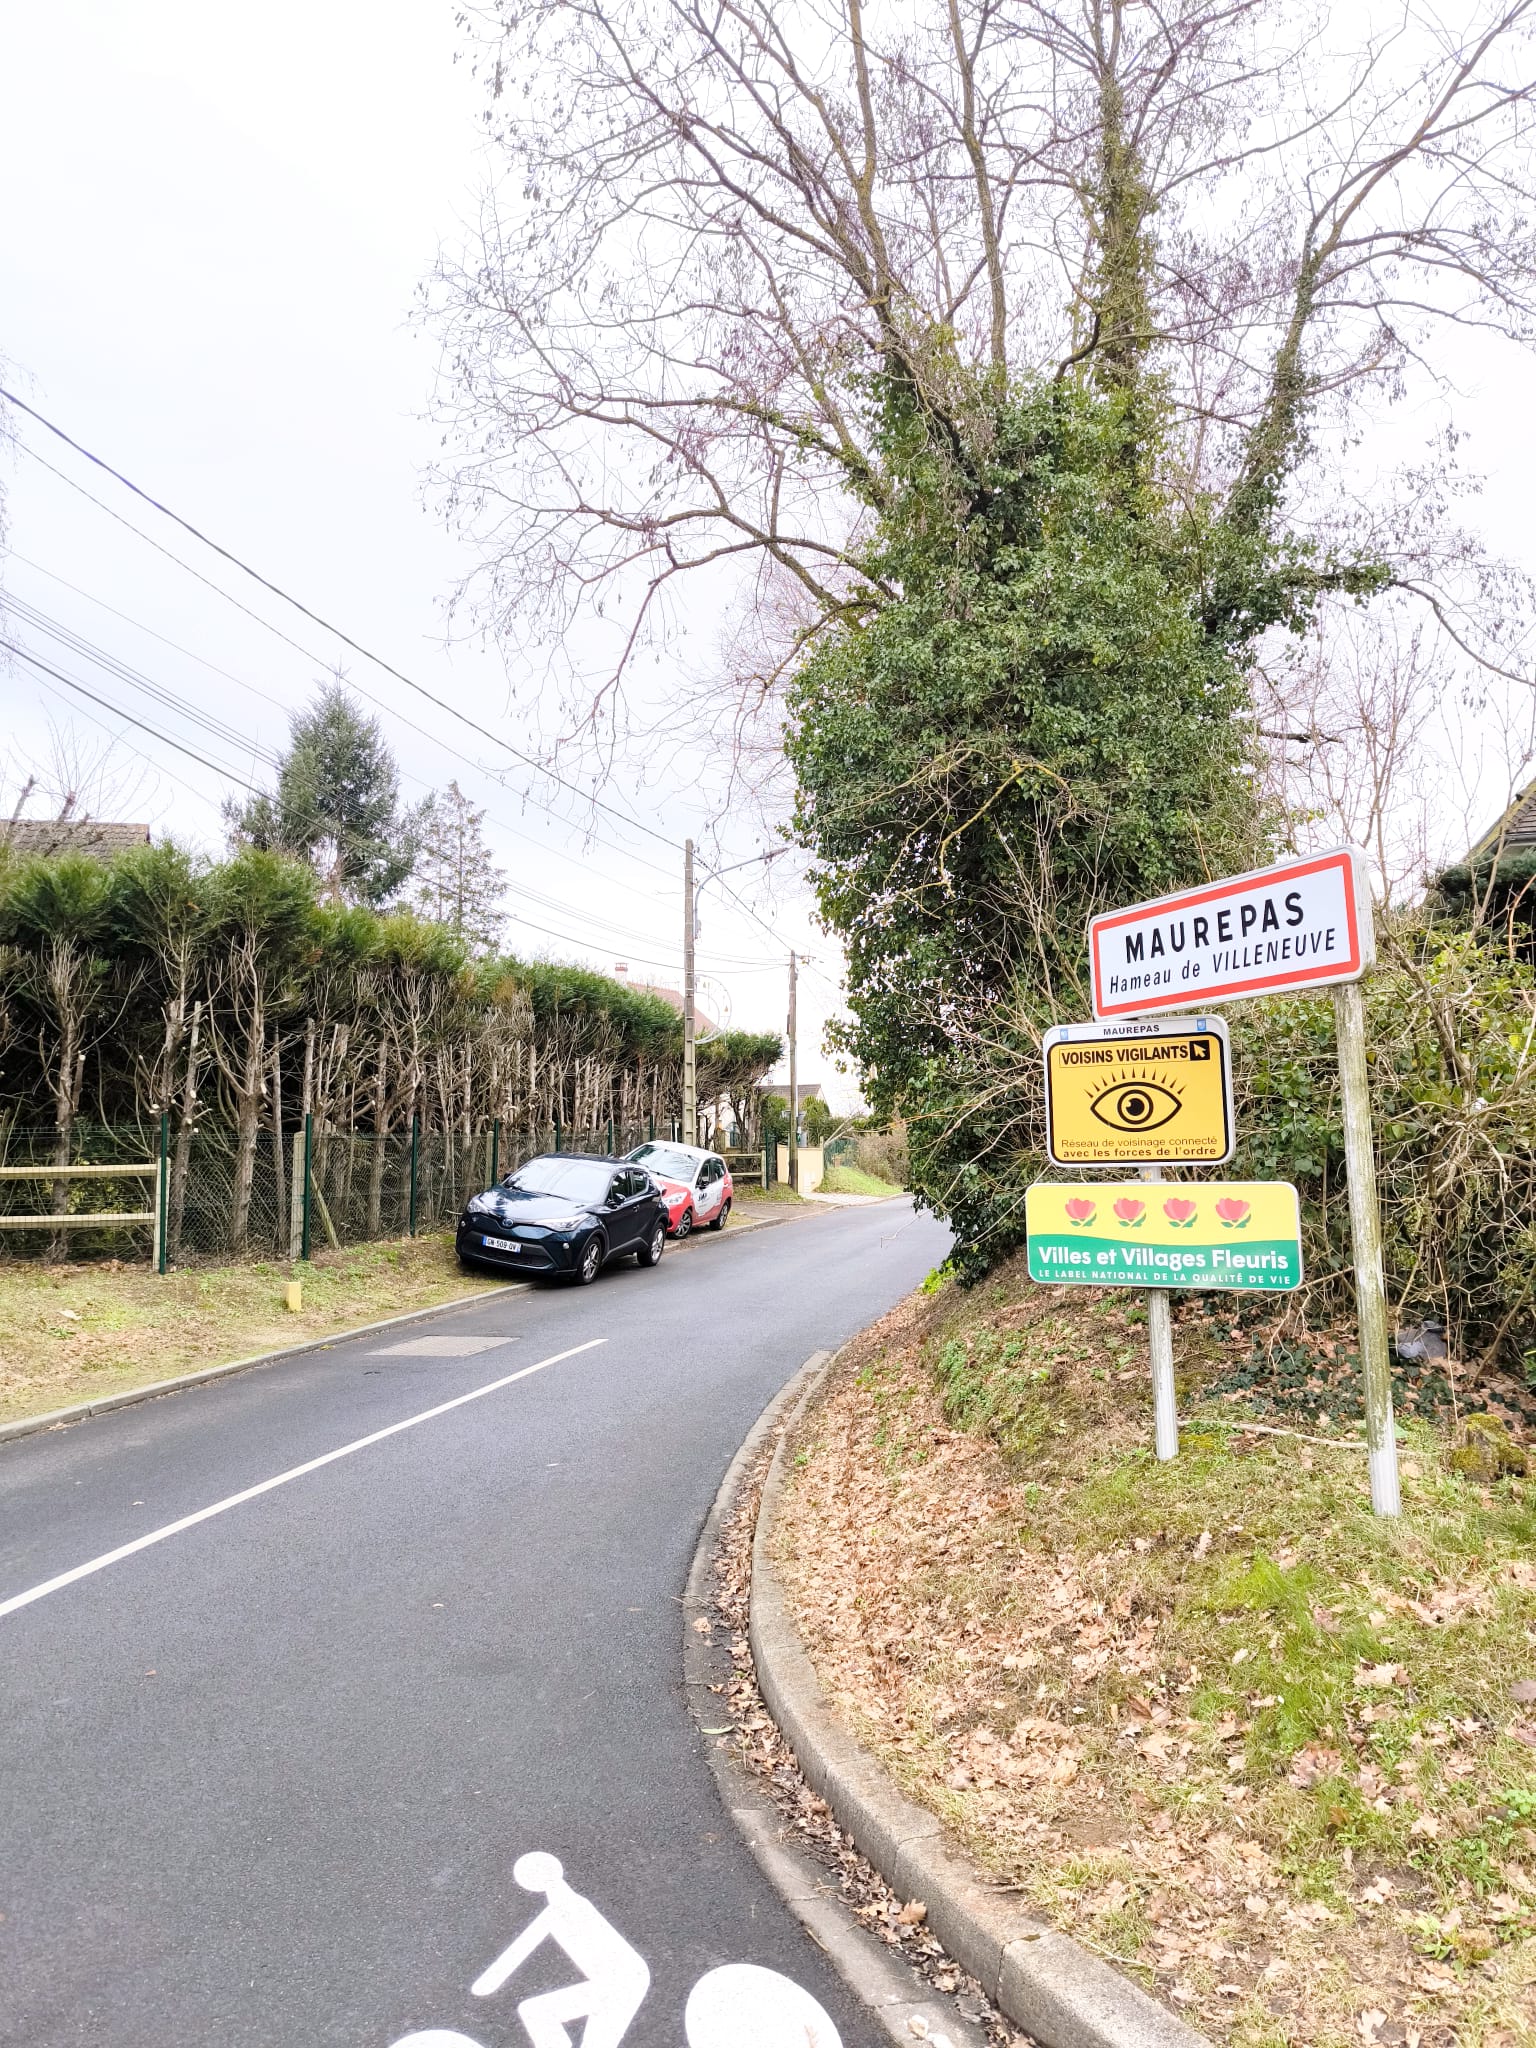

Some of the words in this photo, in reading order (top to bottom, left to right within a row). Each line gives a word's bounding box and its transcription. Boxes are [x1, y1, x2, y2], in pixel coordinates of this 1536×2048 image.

[1125, 892, 1304, 964] MAUREPAS
[1110, 969, 1171, 994] Hameau
[1181, 959, 1201, 980] de
[1213, 928, 1336, 973] VILLENEUVE
[1103, 1024, 1160, 1036] MAUREPAS
[1062, 1050, 1113, 1065] VOISINS
[1116, 1045, 1189, 1062] VIGILANTS
[1061, 1138, 1099, 1148] Réseau
[1102, 1138, 1114, 1147] de
[1117, 1137, 1166, 1148] voisinage
[1168, 1136, 1218, 1146] connecté
[1063, 1150, 1089, 1158] avec
[1093, 1148, 1110, 1157] les
[1114, 1148, 1152, 1157] forces
[1156, 1147, 1171, 1156] de
[1175, 1146, 1217, 1156] l'ordre
[1038, 1246, 1091, 1265] Villes
[1096, 1248, 1118, 1265] et
[1121, 1247, 1206, 1271] Villages
[1212, 1249, 1289, 1270] Fleuris
[1039, 1269, 1050, 1278] LE
[1055, 1270, 1087, 1279] LABEL
[1091, 1271, 1149, 1280] NATIONAL
[1153, 1272, 1168, 1281] DE
[1173, 1273, 1187, 1281] LA
[1192, 1272, 1243, 1284] QUALITÉ
[1249, 1275, 1264, 1284] DE
[1270, 1275, 1291, 1285] VIE
